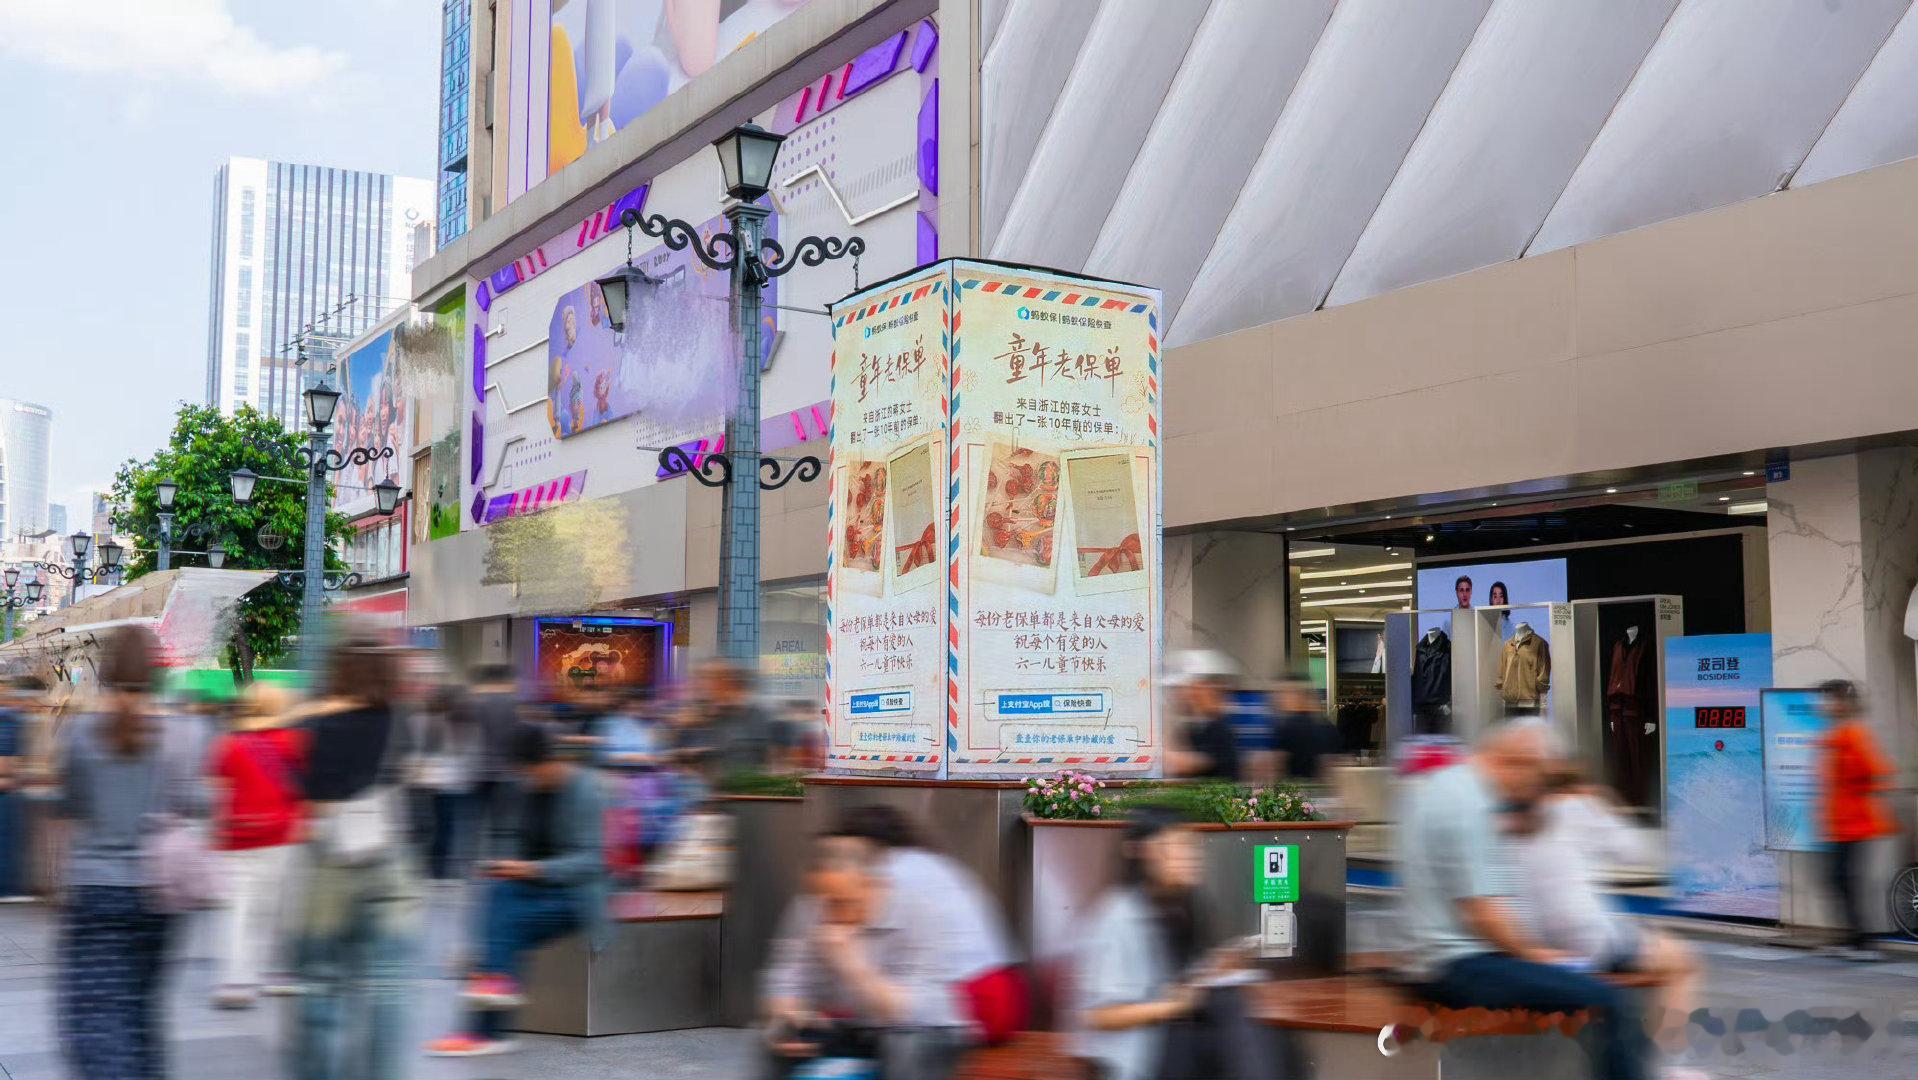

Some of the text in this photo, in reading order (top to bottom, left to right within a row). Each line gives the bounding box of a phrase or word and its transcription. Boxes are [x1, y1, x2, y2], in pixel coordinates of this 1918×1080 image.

[851, 334, 927, 403] 童年老保单
[994, 332, 1125, 398] 童年老保单
[863, 400, 912, 423] 来自浙江的蒋女士
[1016, 398, 1101, 417] 来自浙江的蒋女士
[839, 607, 937, 632] 每份老保单都是来自父母的爱
[974, 611, 1145, 632] 每份老保单都是来自父母的爱
[859, 633, 913, 652] 祝每个有爱的人
[1013, 633, 1108, 652] 祝每个有爱的人
[859, 656, 913, 675] 六一儿童节快乐
[1015, 655, 1107, 674] 六一儿童节快乐
[1697, 657, 1740, 672] 波司登
[1697, 672, 1741, 681] BOSIDENG
